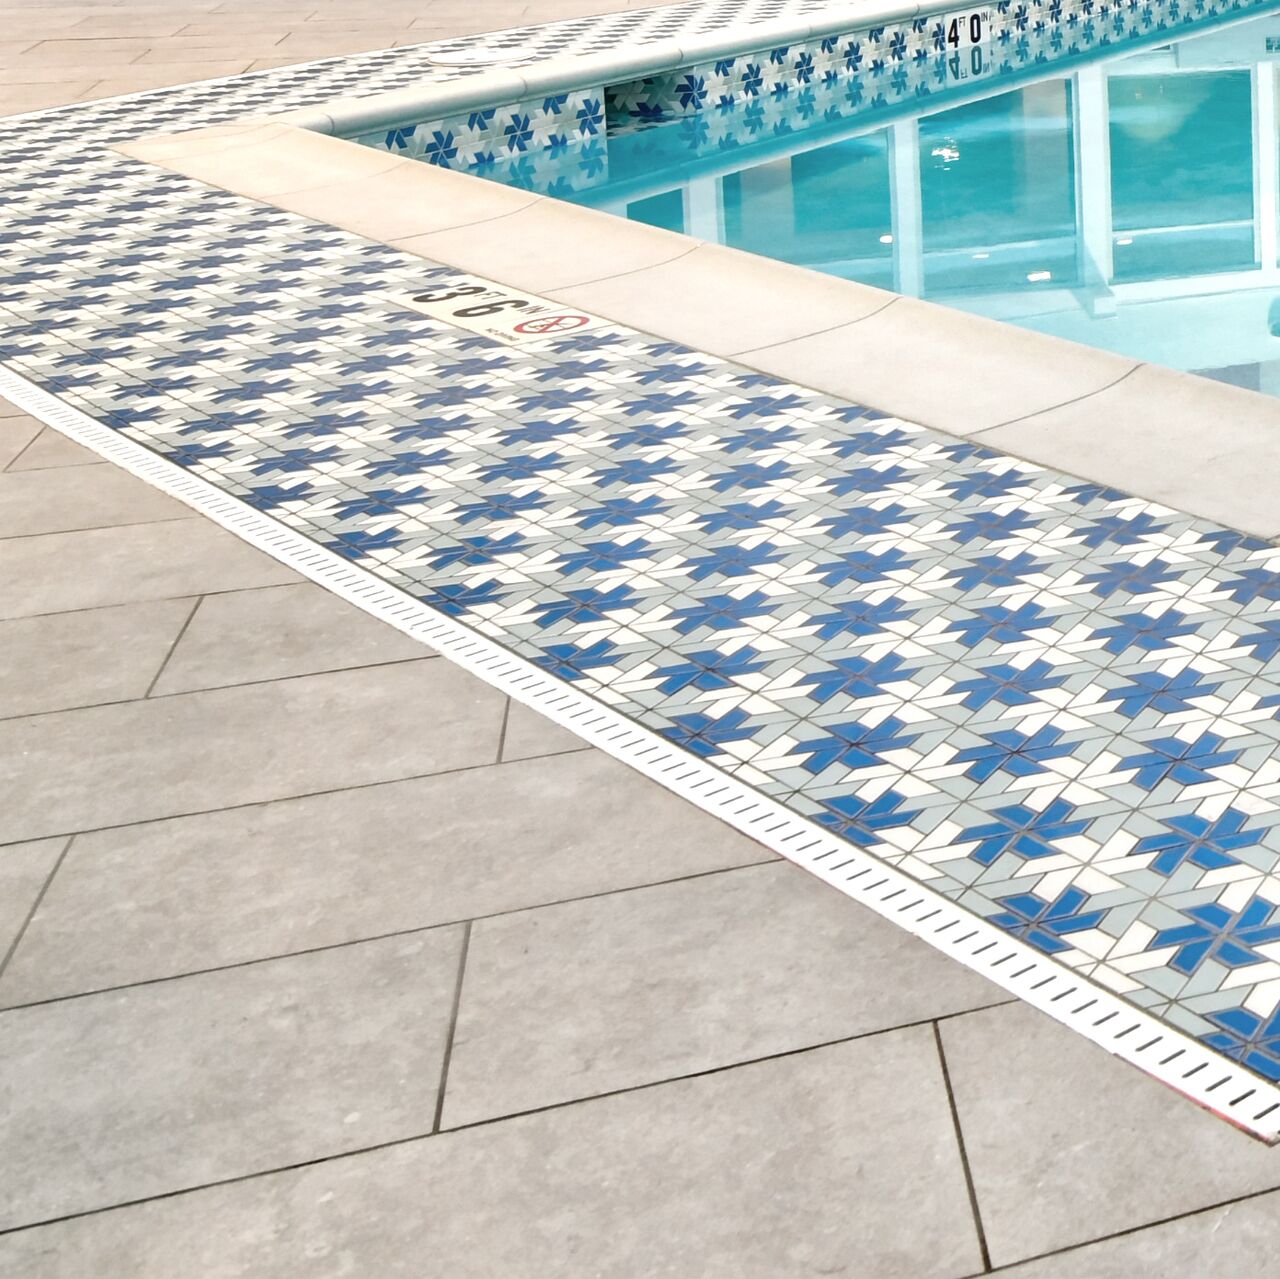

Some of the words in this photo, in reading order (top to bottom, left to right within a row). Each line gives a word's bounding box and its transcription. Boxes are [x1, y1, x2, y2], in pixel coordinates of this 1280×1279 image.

[948, 18, 960, 48] 4
[959, 16, 966, 27] FT
[970, 14, 981, 43] 0
[412, 286, 487, 303] 3
[452, 300, 529, 318] 6
